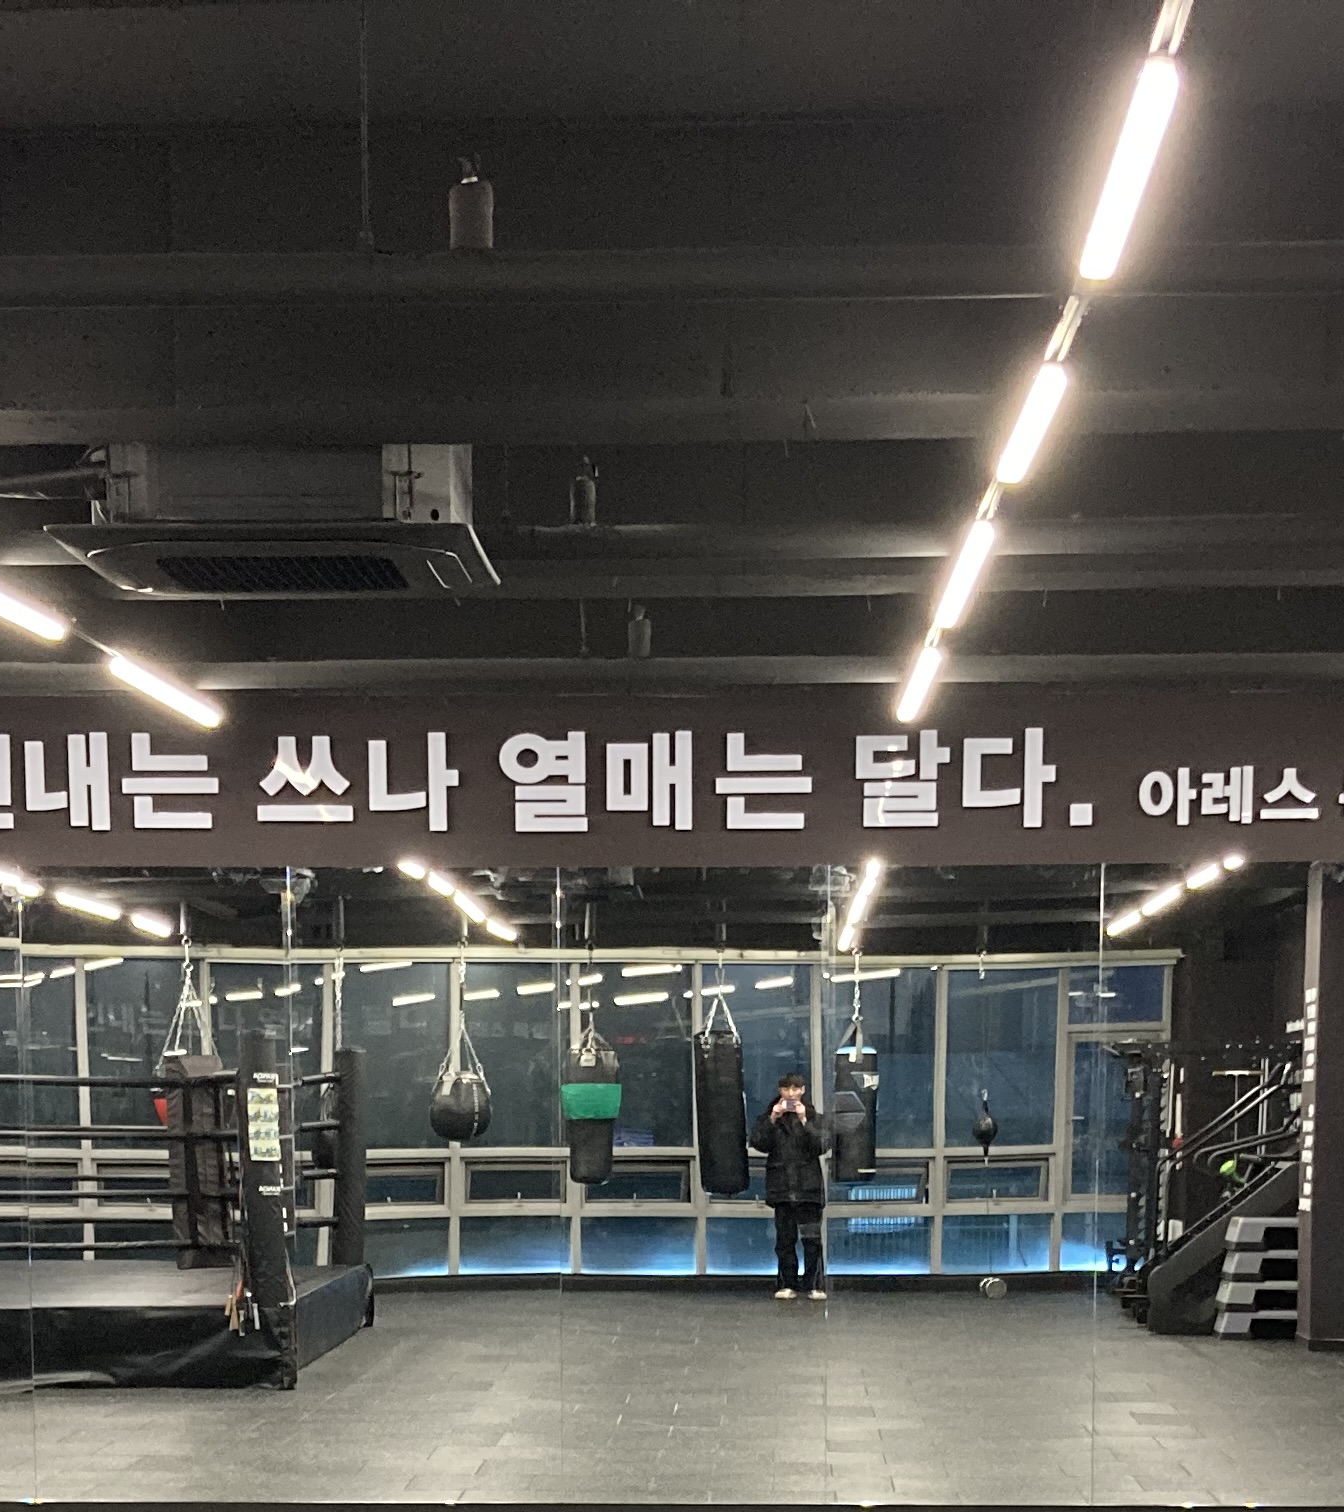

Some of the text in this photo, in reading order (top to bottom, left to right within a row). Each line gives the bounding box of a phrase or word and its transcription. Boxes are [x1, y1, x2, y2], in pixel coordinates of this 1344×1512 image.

[257, 731, 460, 832] 쓰나
[499, 729, 813, 832] 열매는
[855, 726, 1094, 829] 달다.
[1138, 764, 1320, 826] 아레스
